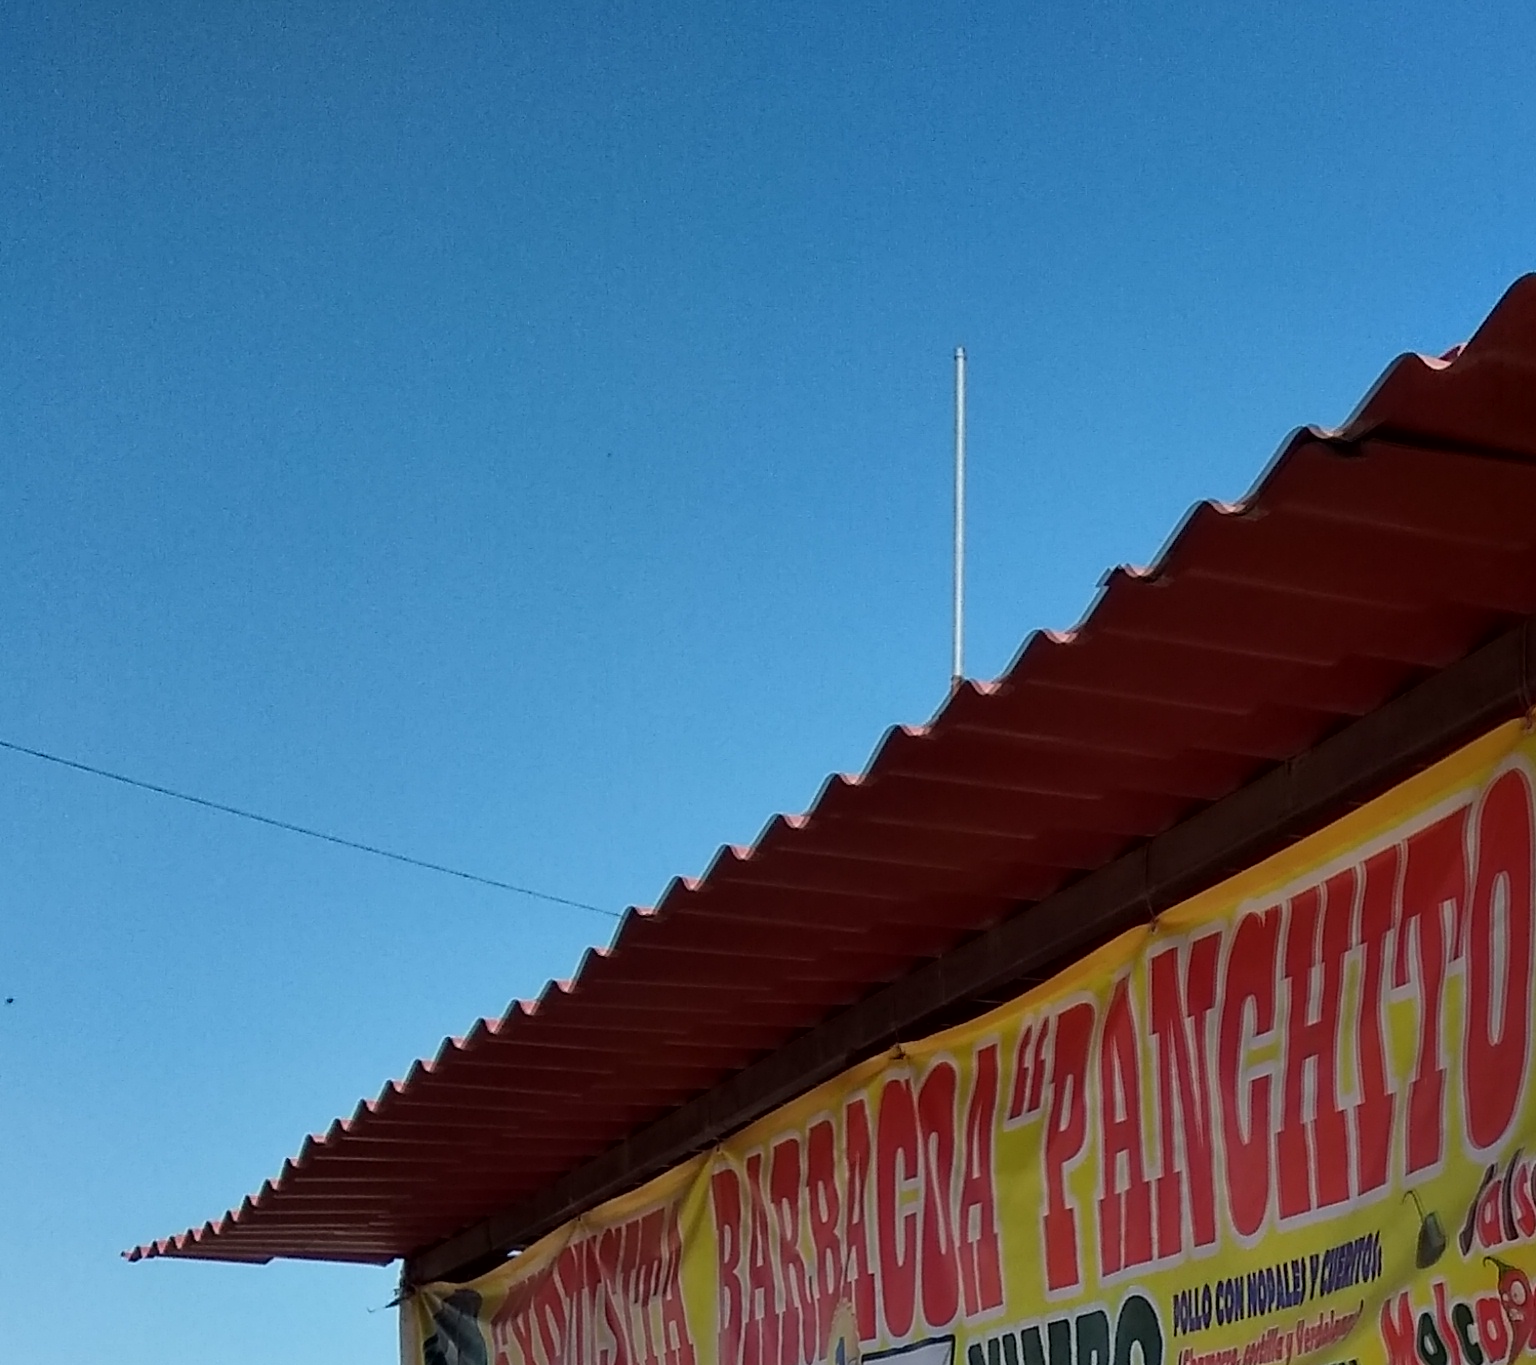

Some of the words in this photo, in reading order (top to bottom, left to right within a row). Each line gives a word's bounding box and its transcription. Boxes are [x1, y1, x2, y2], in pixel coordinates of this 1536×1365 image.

[1173, 1283, 1213, 1337] POLLO
[1216, 1276, 1244, 1326] CON
[1247, 1257, 1307, 1318] NOPALES
[1310, 1254, 1320, 1300] Y
